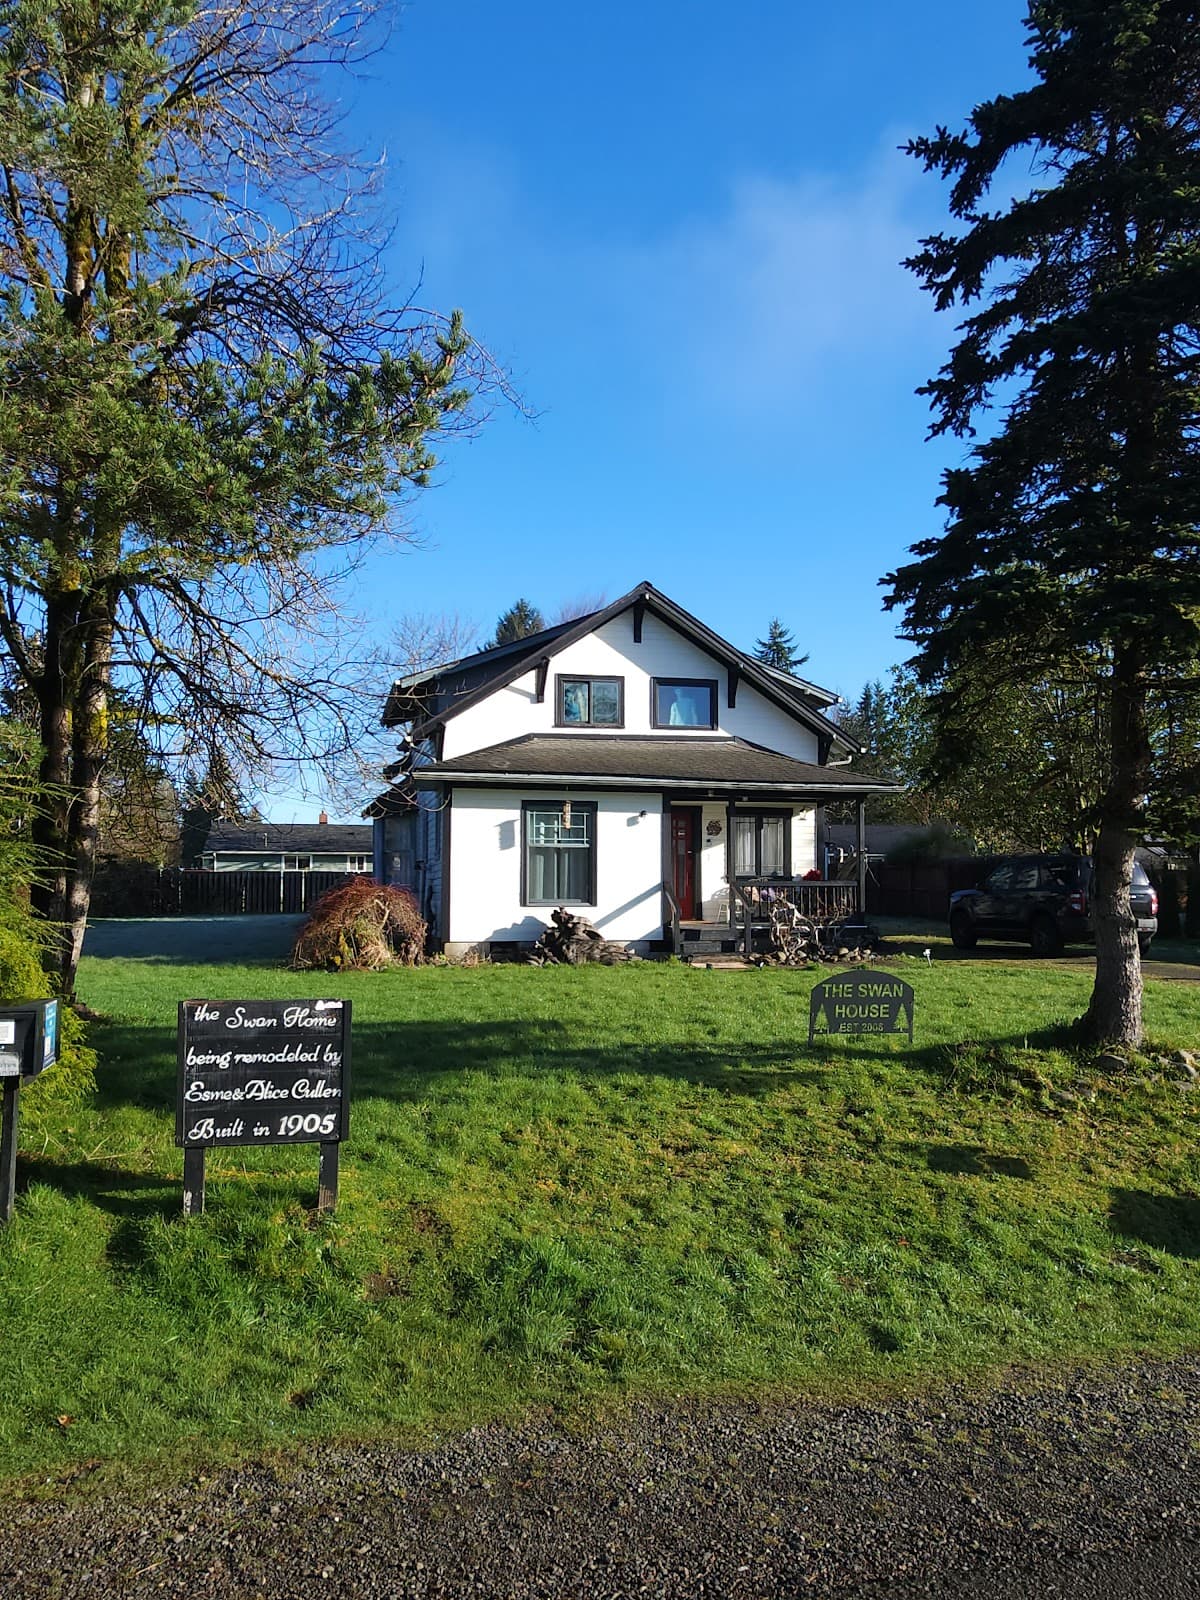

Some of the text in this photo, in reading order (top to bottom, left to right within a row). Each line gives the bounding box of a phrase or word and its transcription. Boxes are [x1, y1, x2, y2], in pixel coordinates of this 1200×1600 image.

[822, 984, 904, 998] THE SWAN
[194, 1003, 337, 1029] the Swan Home
[835, 1004, 890, 1018] HOUSE
[839, 1022, 859, 1032] EST
[186, 1043, 342, 1069] being remodeled by
[291, 1079, 342, 1100] Cullen
[188, 1113, 338, 1140] Built in 1905
